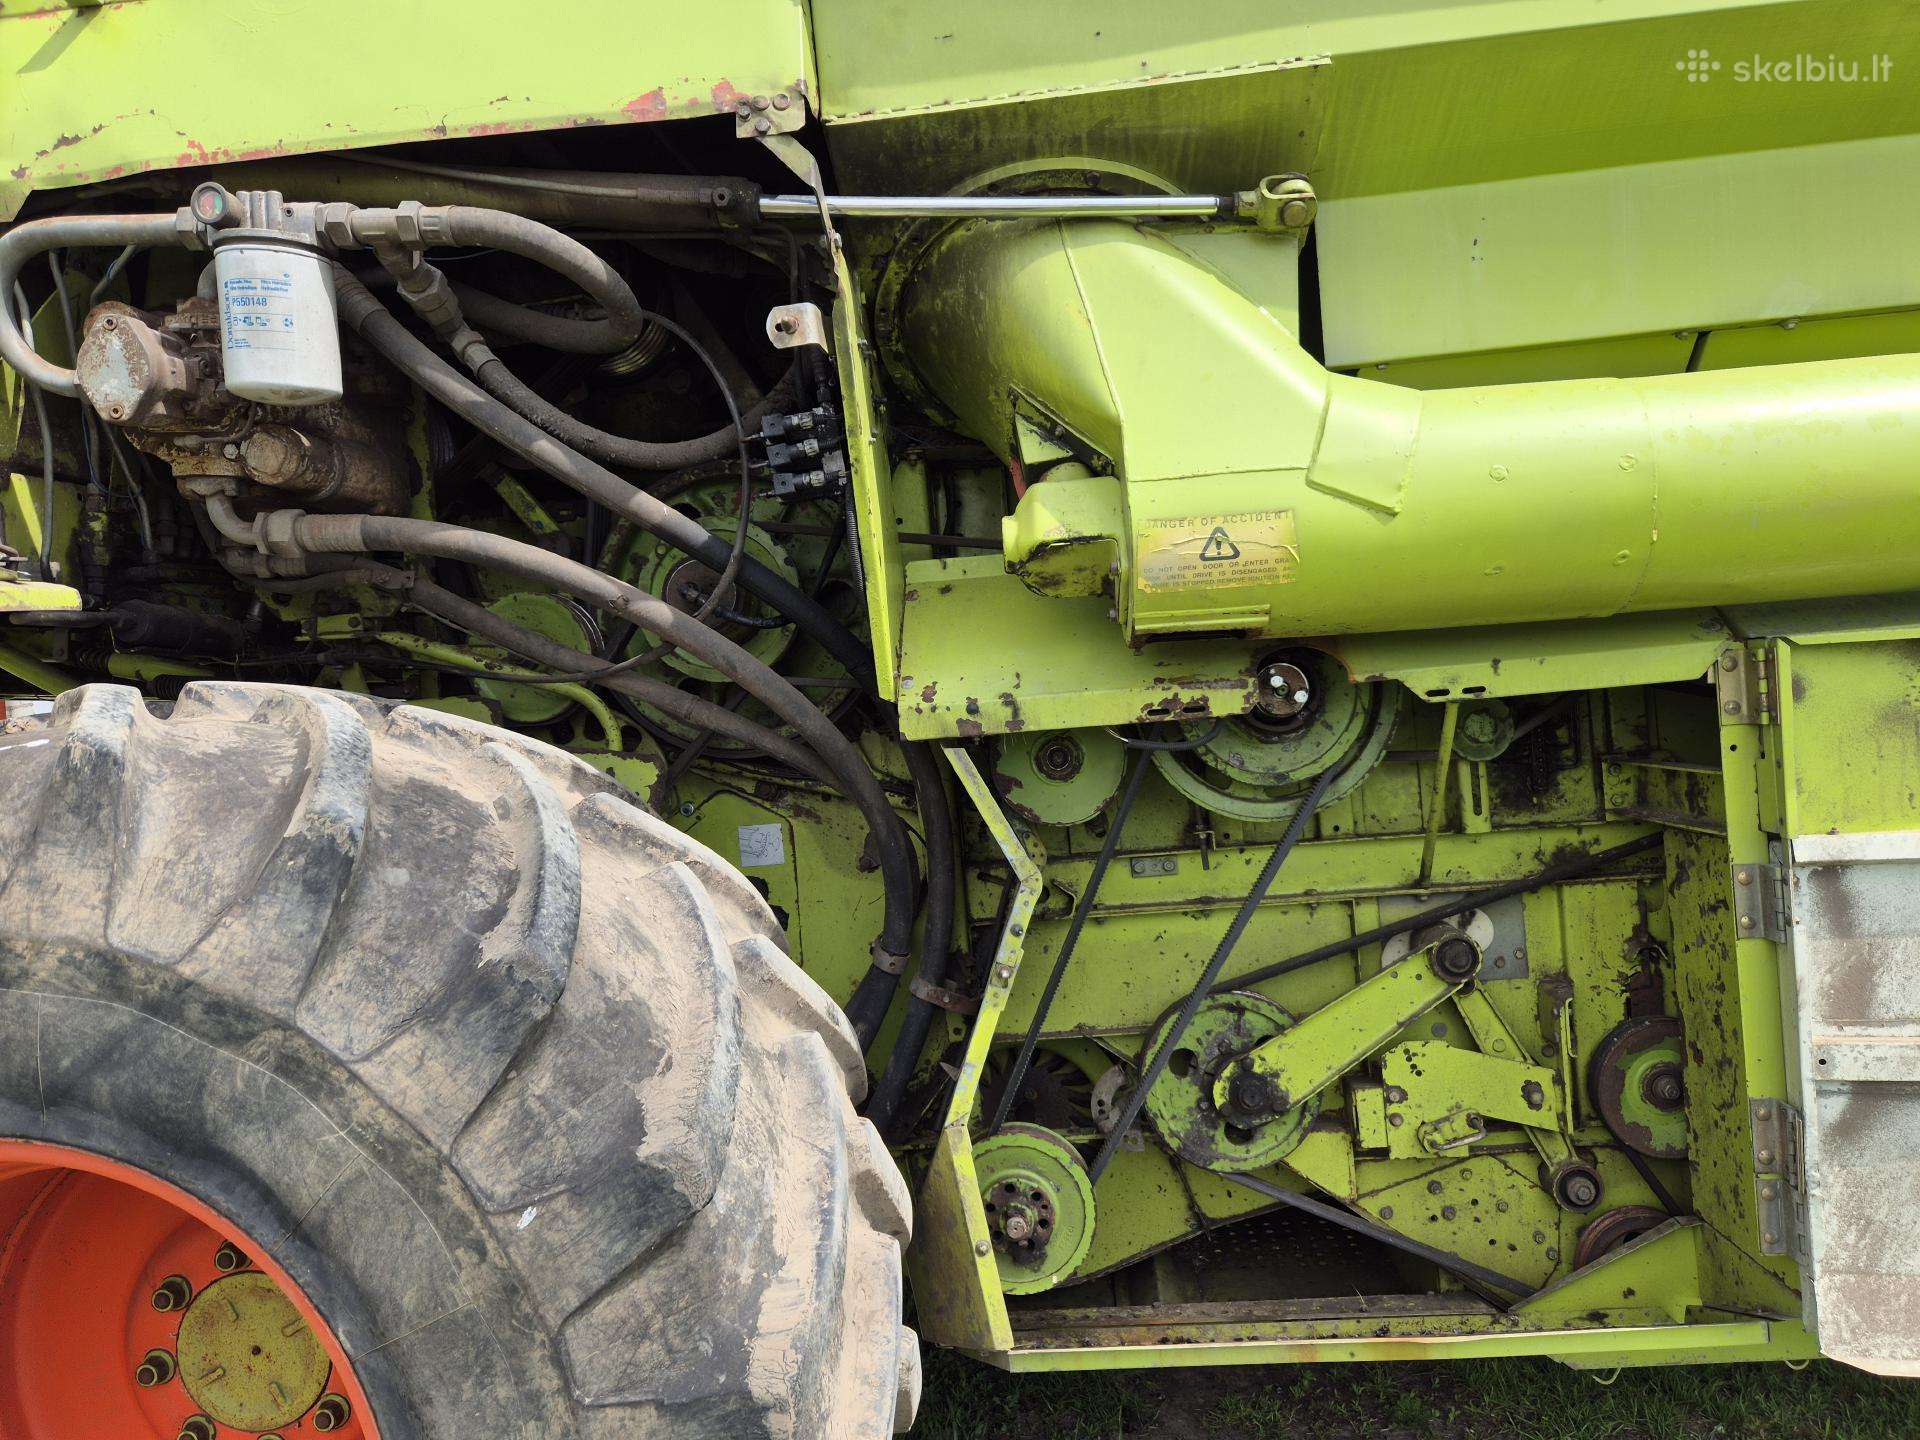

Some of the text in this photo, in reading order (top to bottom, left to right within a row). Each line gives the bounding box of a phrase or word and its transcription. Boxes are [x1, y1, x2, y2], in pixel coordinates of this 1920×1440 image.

[1145, 512, 1288, 529] DANGER OF ACCIDENT
[1202, 562, 1224, 570] DOOR
[1244, 559, 1269, 567] ENTER
[1192, 571, 1213, 579] DRIVE
[1231, 567, 1277, 576] DISENGAGED
